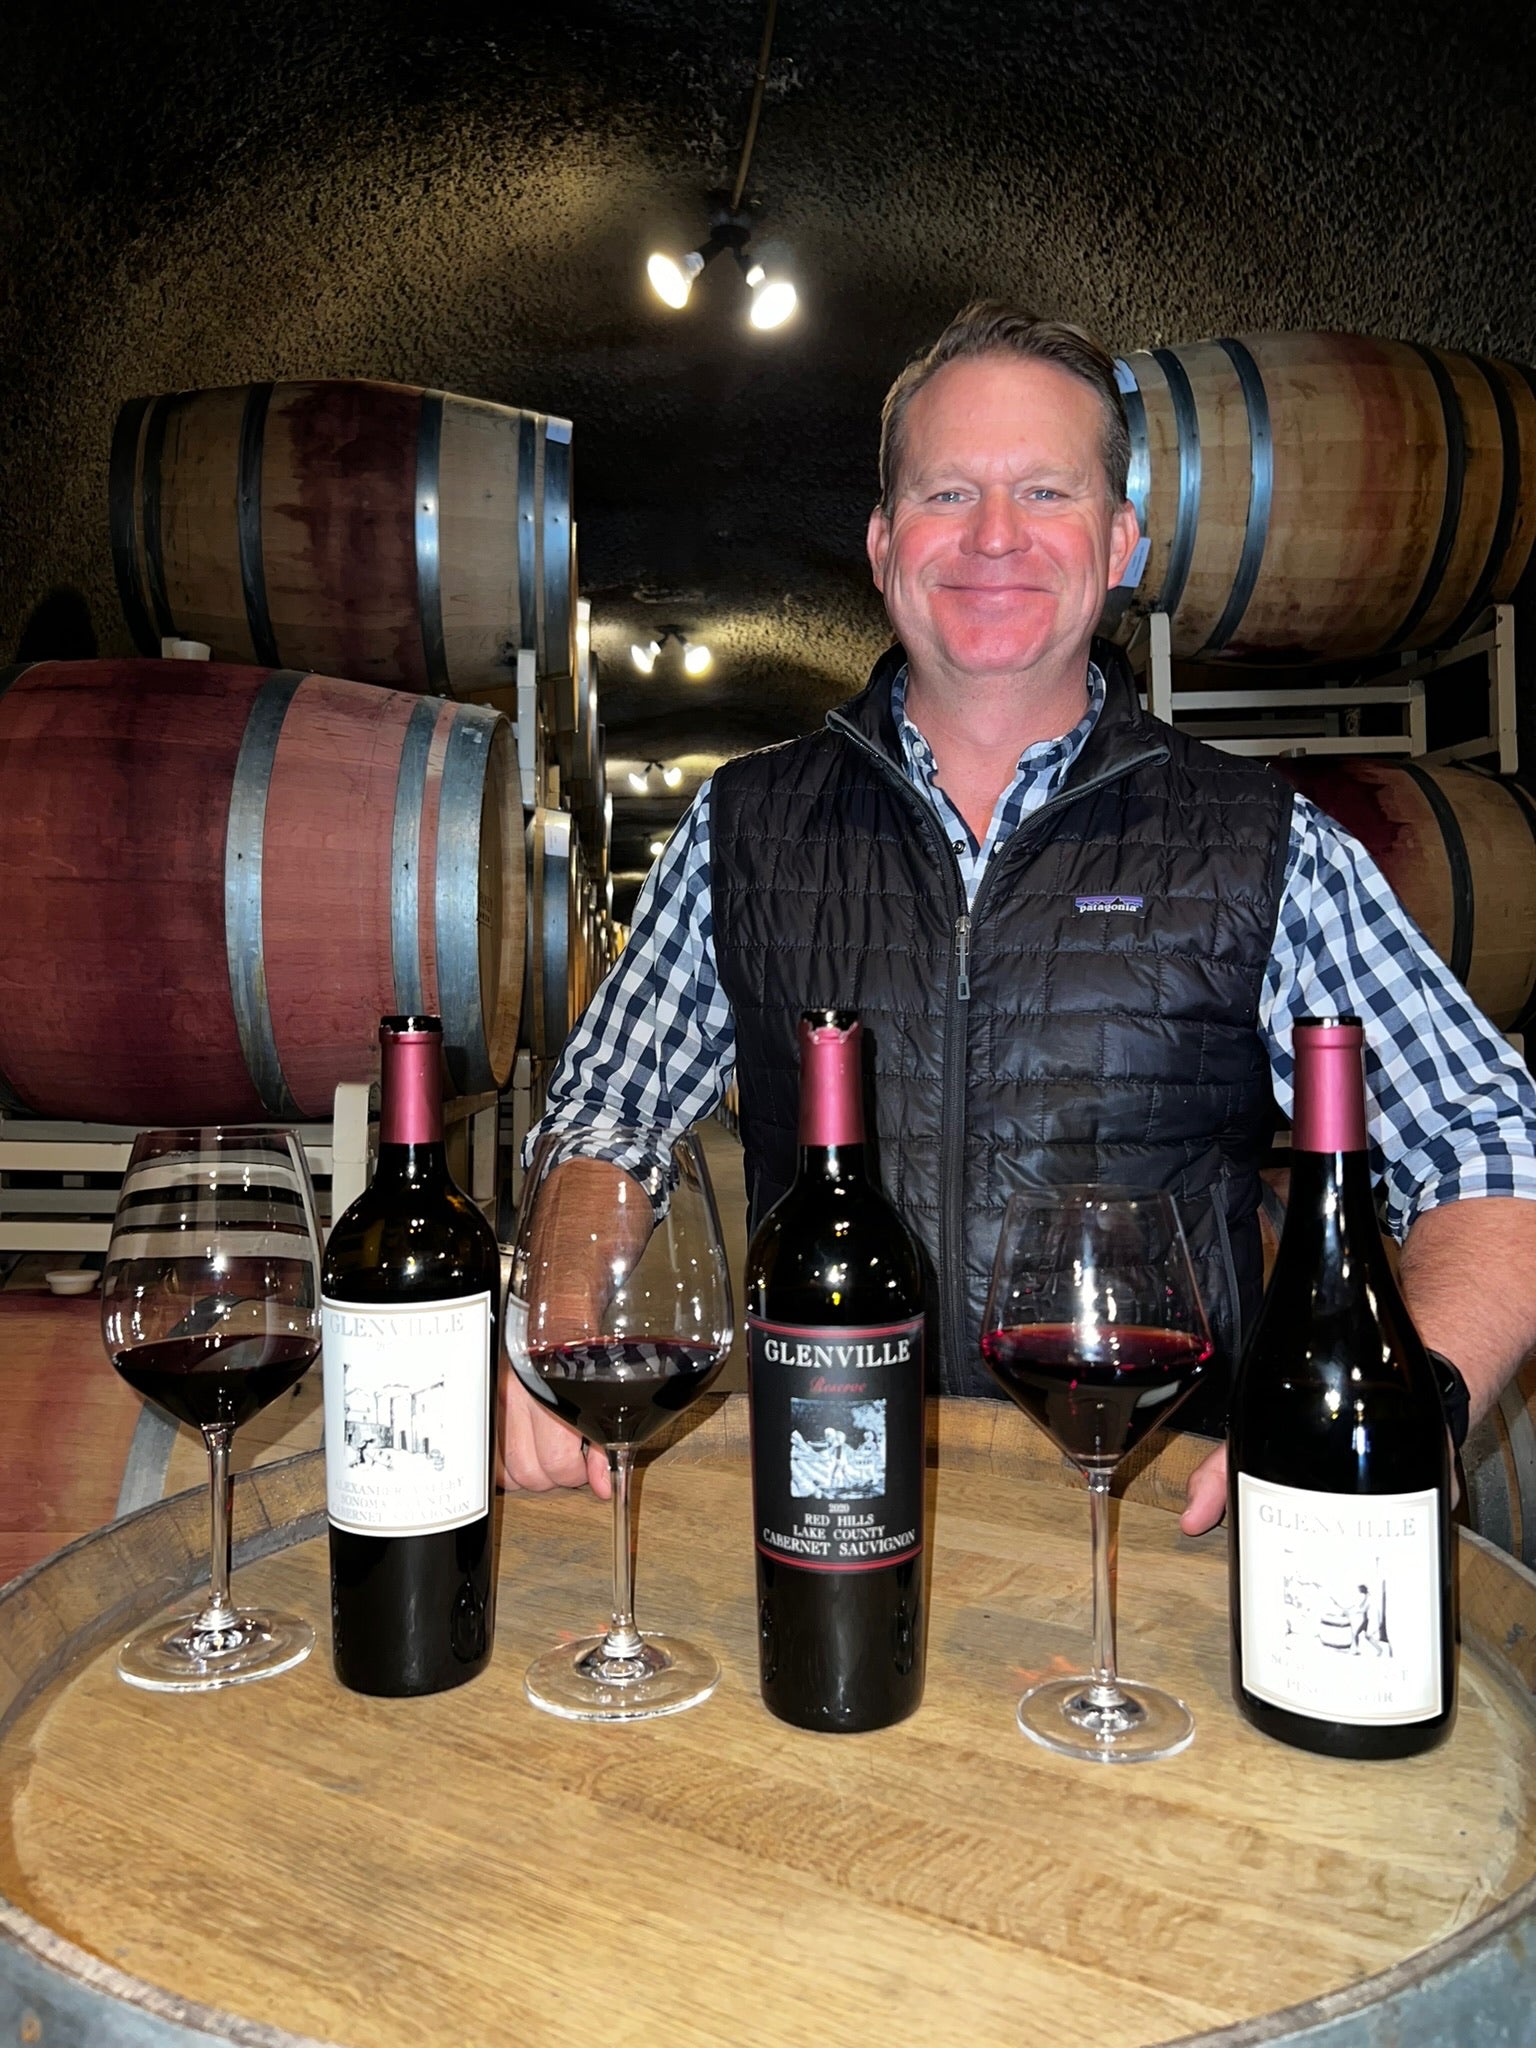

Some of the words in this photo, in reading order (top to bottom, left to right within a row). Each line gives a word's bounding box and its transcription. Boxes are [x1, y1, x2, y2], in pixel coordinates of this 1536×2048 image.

[1079, 903, 1137, 913] patagonia
[764, 1338, 911, 1368] GLENVILLE
[809, 1376, 866, 1393] Reserve
[828, 1503, 850, 1513] 2020
[804, 1513, 830, 1525] RED
[837, 1513, 874, 1527] HILLS
[793, 1524, 826, 1540] LAKE
[833, 1525, 885, 1541] COUNTY
[763, 1528, 831, 1556] CABERNET
[839, 1529, 915, 1556] SAUVIGNON
